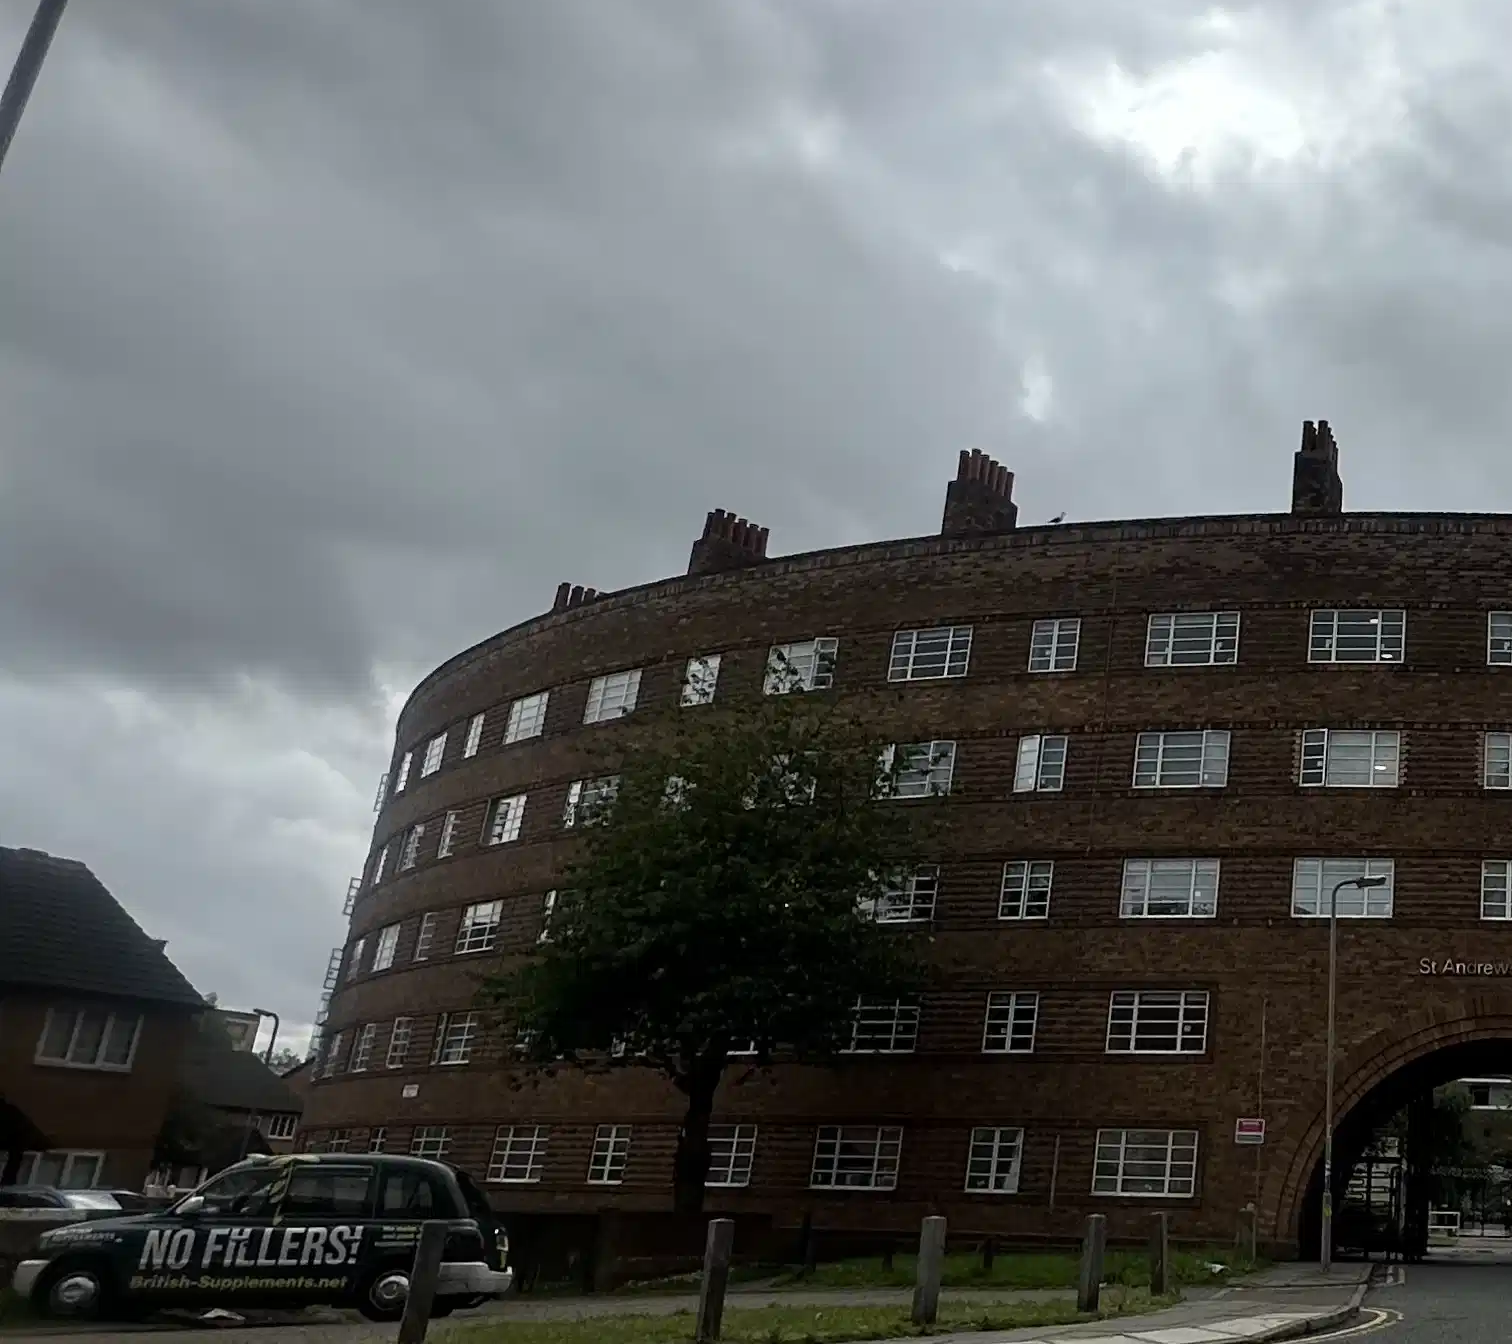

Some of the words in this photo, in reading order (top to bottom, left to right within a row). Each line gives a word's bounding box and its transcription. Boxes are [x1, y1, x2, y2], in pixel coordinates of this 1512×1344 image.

[1419, 957, 1437, 975] St
[139, 1228, 196, 1270] NO
[201, 1225, 364, 1269] FILLERS!
[129, 1274, 348, 1292] British-Supplements.net
